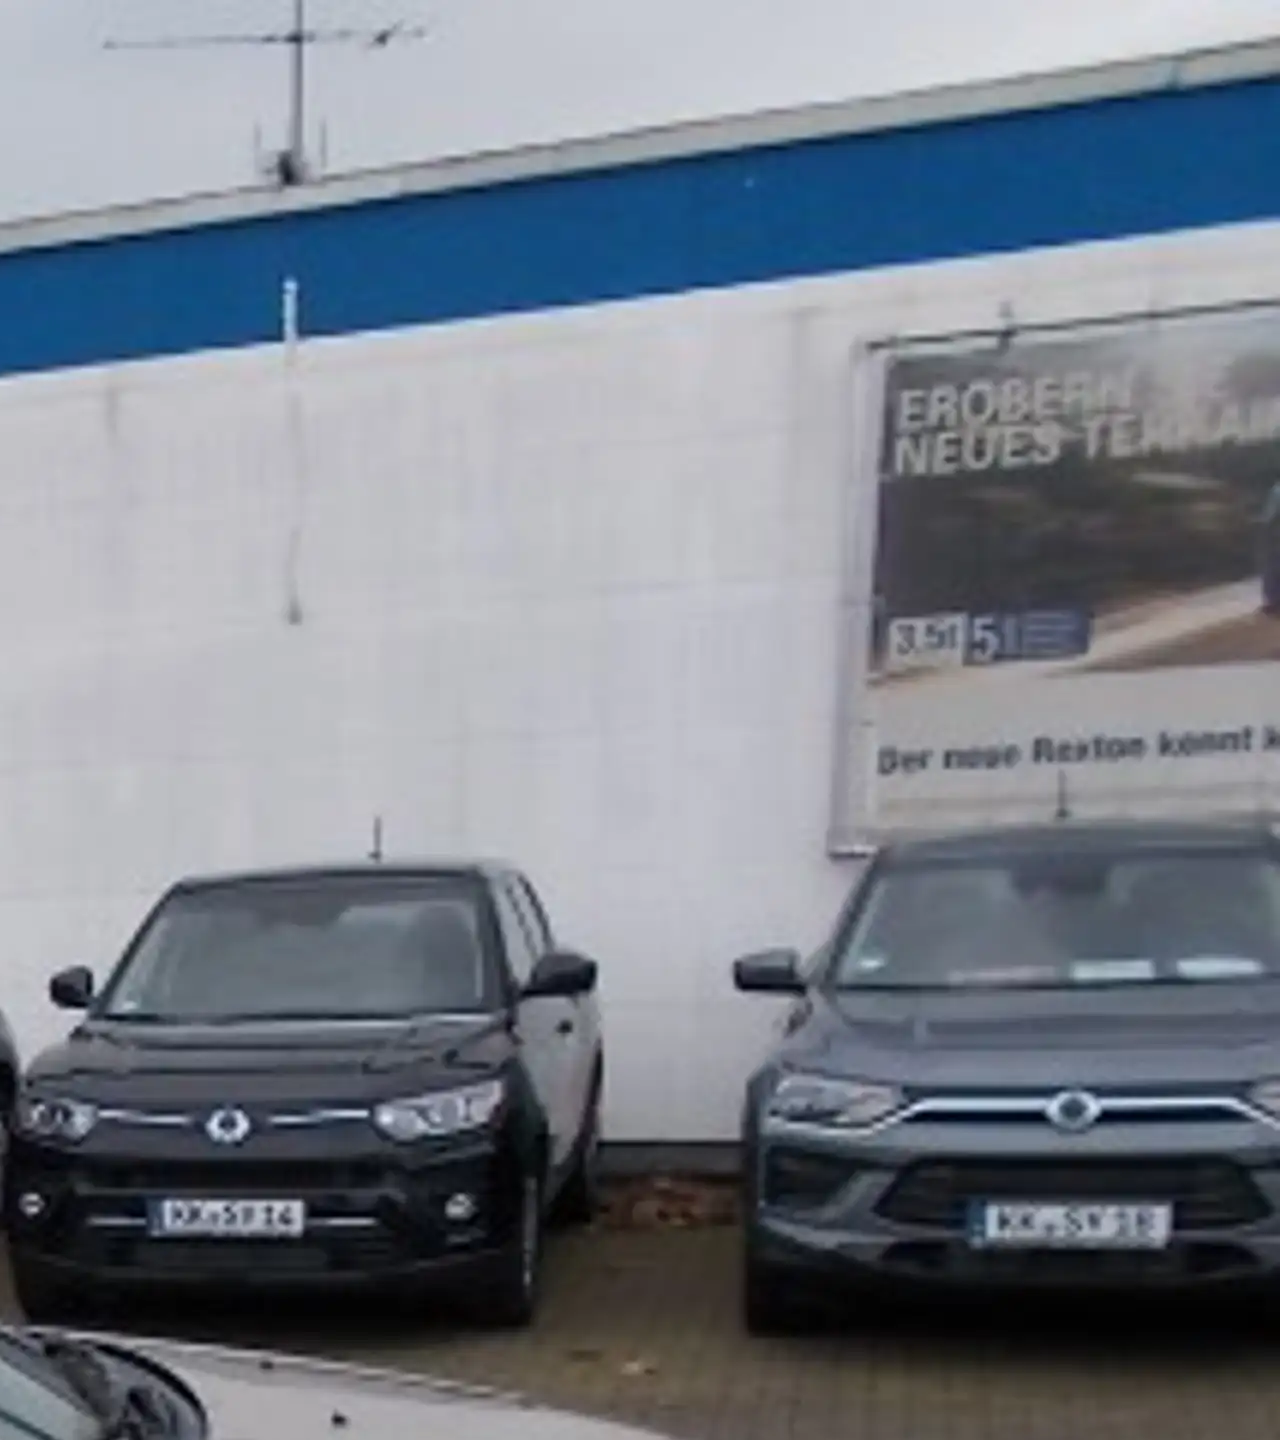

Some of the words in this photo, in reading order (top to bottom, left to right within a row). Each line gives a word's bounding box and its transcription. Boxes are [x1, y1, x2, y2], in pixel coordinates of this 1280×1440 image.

[898, 372, 1134, 432] EROBERN
[894, 420, 1061, 476] NEUES
[877, 744, 933, 776] Der
[1032, 734, 1144, 766] Rexton
